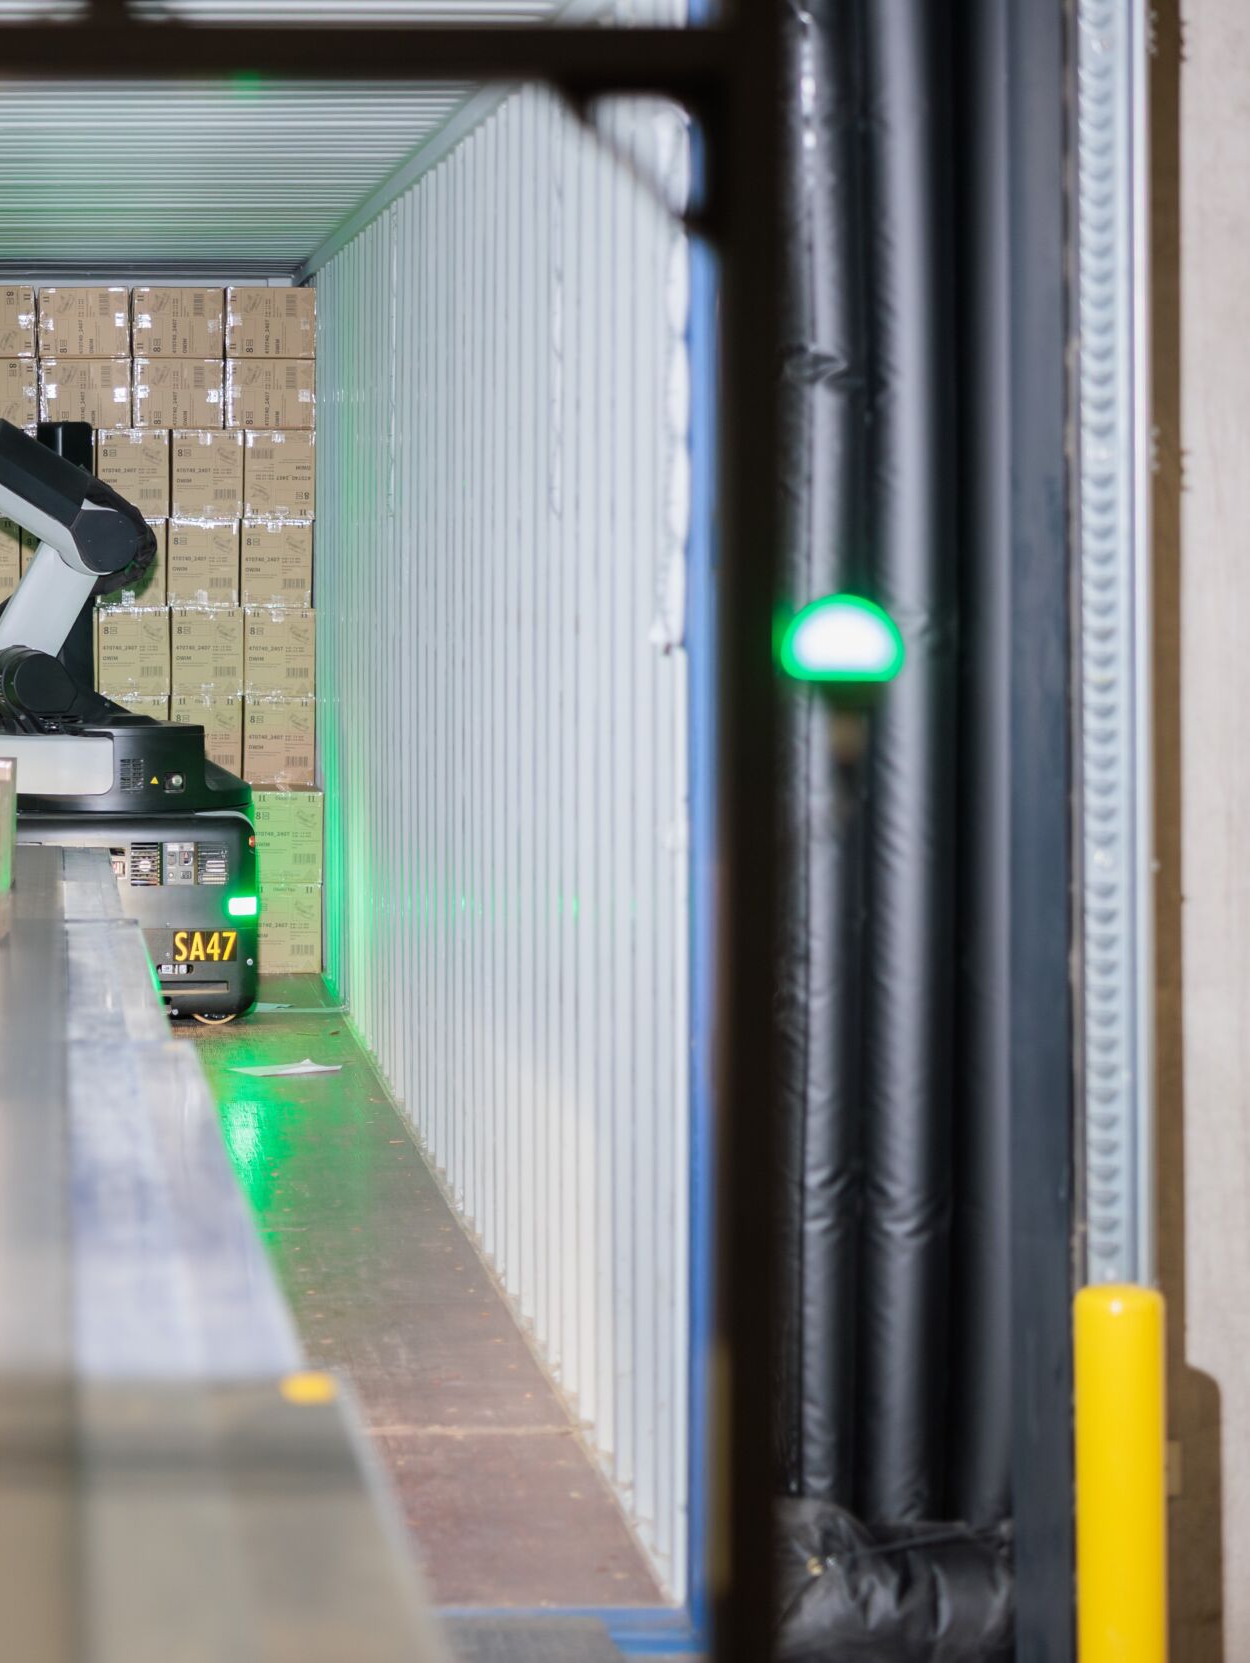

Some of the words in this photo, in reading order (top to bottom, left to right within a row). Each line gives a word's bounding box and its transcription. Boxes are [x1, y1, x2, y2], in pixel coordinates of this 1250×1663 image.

[103, 449, 108, 457] 8
[177, 449, 183, 457] 8
[304, 492, 310, 500] 8
[173, 537, 179, 546] 8
[246, 538, 252, 546] 8
[103, 626, 109, 634] 8
[177, 626, 183, 634] 8
[250, 627, 256, 635] 8
[176, 714, 182, 722] 8
[250, 715, 256, 724] 8
[255, 811, 261, 820] 8
[174, 932, 237, 961] SA47
